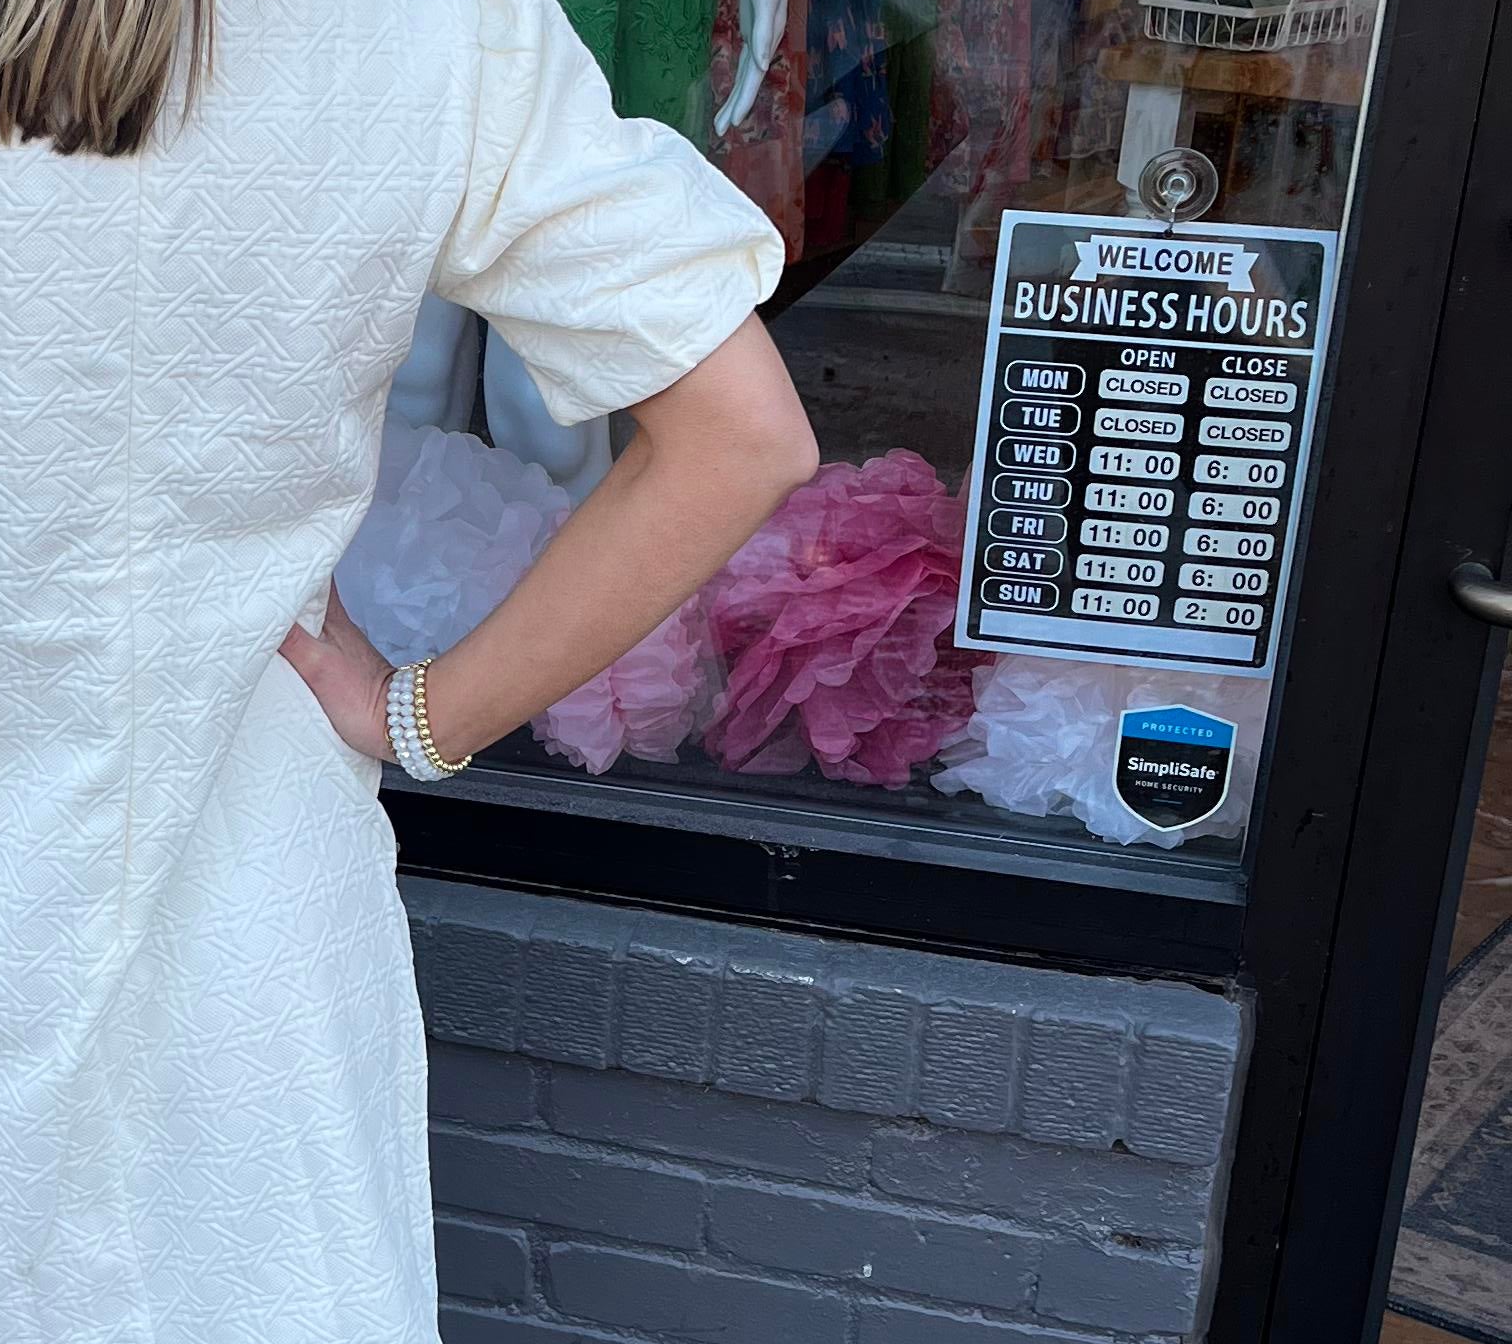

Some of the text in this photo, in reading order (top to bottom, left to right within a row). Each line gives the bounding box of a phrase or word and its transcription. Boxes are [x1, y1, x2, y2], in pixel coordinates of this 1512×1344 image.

[1098, 244, 1234, 275] WELCOME
[1013, 281, 1308, 339] BUSINESS HOURS
[1120, 348, 1288, 377] OPEN CLOSE
[1021, 367, 1288, 406] MON CLOSED CLOSED
[1021, 406, 1285, 445] TUE CLOSED CLOSED
[1013, 443, 1061, 466] WED
[1011, 479, 1054, 501] THU
[1011, 516, 1045, 536] FRI
[1002, 550, 1047, 570] SAT
[998, 583, 1042, 604] SUN
[1141, 721, 1214, 738] PROTECTED
[1127, 756, 1217, 781] SimpliSafe
[1135, 779, 1203, 794] HOME SECURITY
